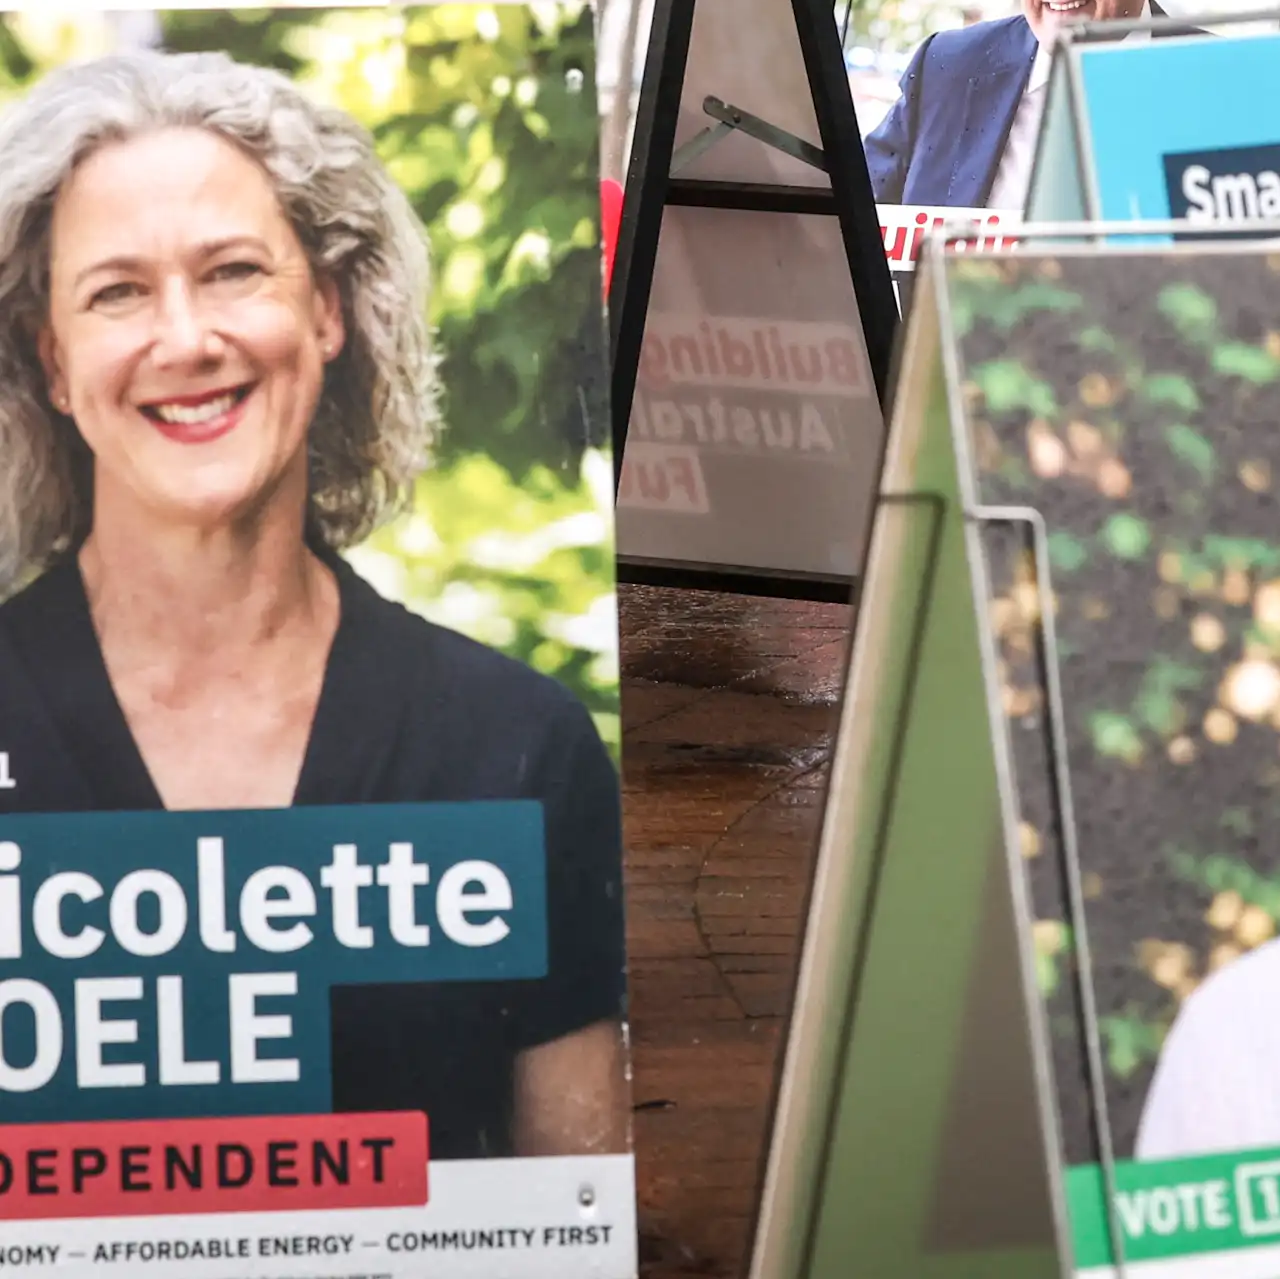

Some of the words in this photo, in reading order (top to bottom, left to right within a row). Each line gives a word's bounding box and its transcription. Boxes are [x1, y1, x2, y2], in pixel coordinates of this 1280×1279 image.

[0, 836, 514, 960] icolette
[0, 971, 301, 1094] OELE
[94, 1239, 250, 1263] AFFORDABLE
[258, 1235, 354, 1258] ENERGY
[386, 1228, 535, 1252] COMMUNITY
[543, 1225, 613, 1247] FIRST
[1113, 1179, 1233, 1239] VOTE
